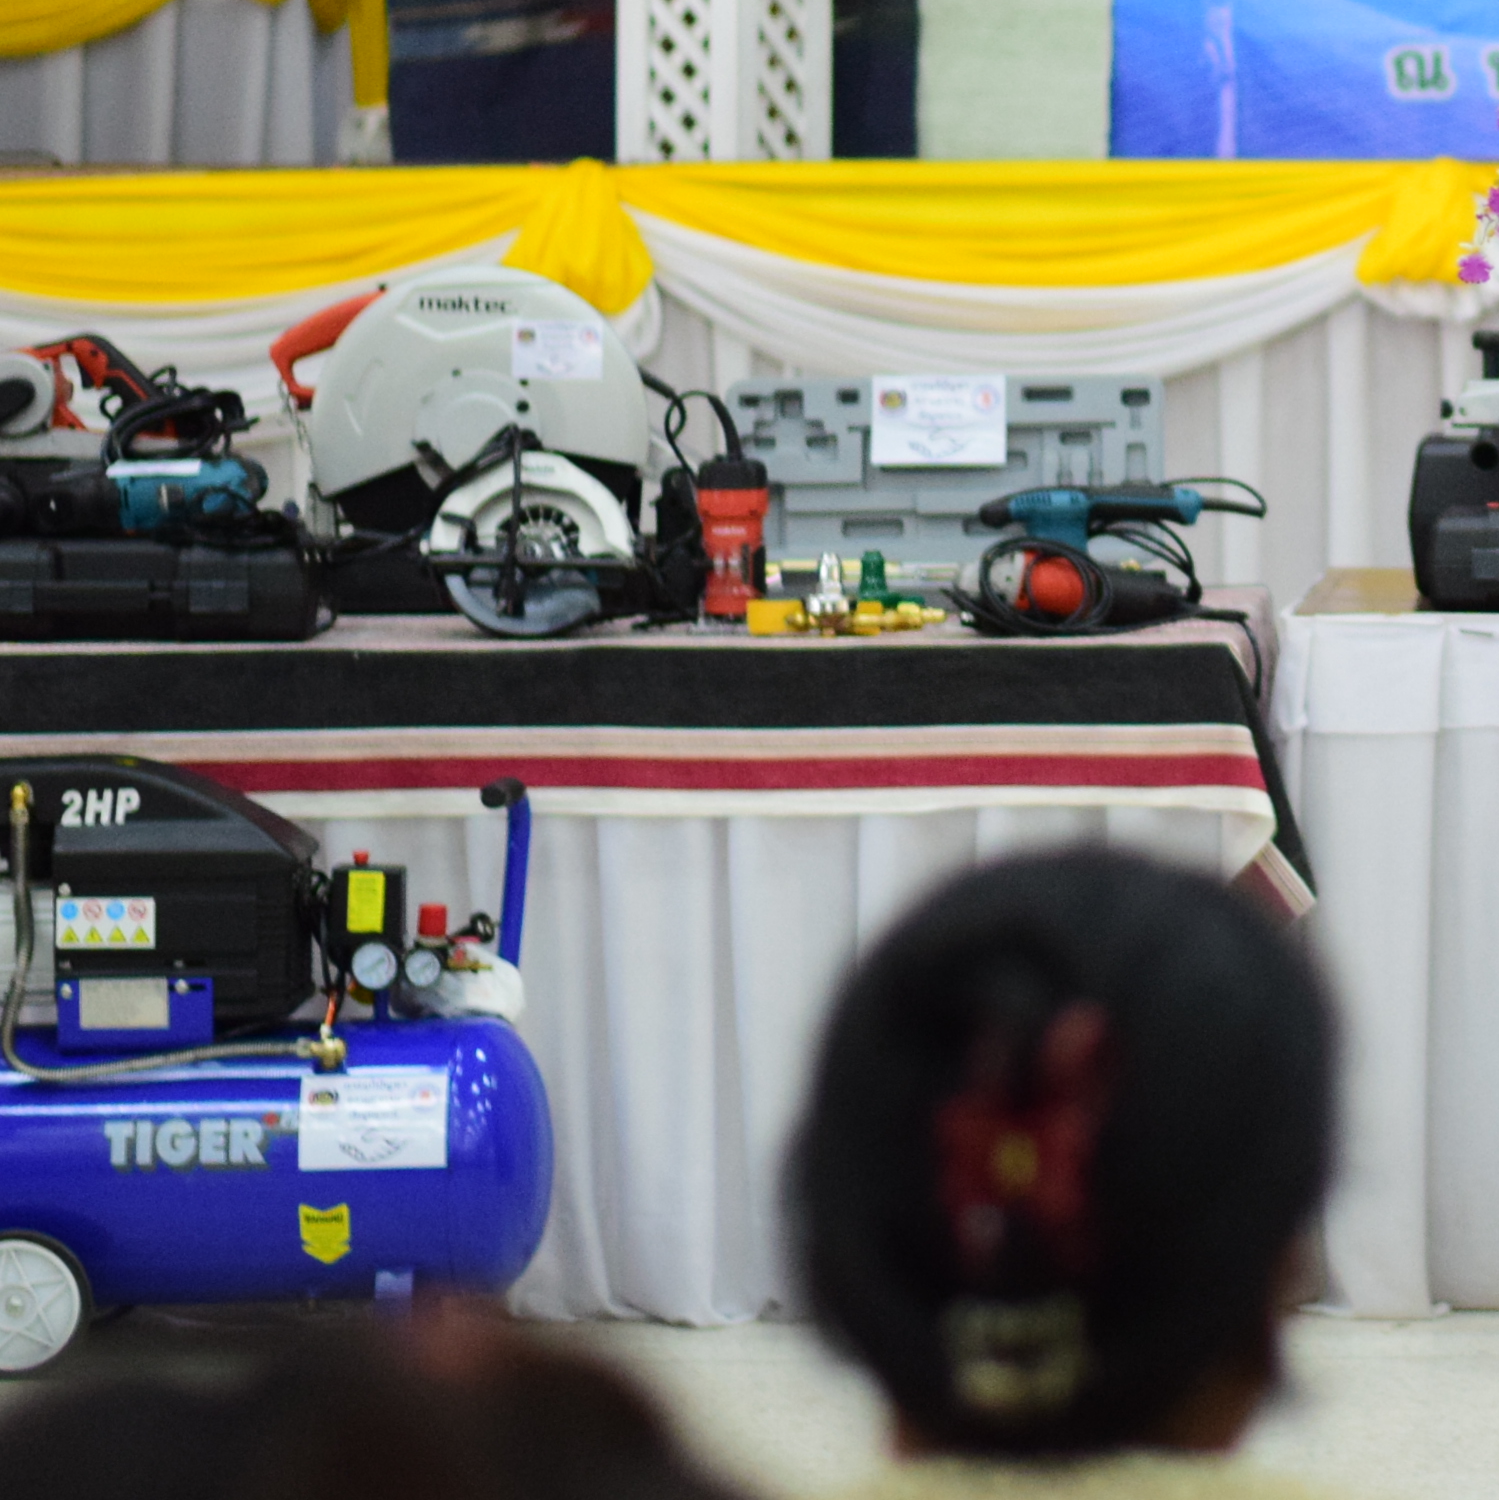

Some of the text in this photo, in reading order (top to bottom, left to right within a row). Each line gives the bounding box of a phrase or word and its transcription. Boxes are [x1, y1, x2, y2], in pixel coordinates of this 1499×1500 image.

[1393, 50, 1449, 91] ณ
[60, 786, 141, 828] 2HP
[104, 1119, 270, 1168] TIGER
